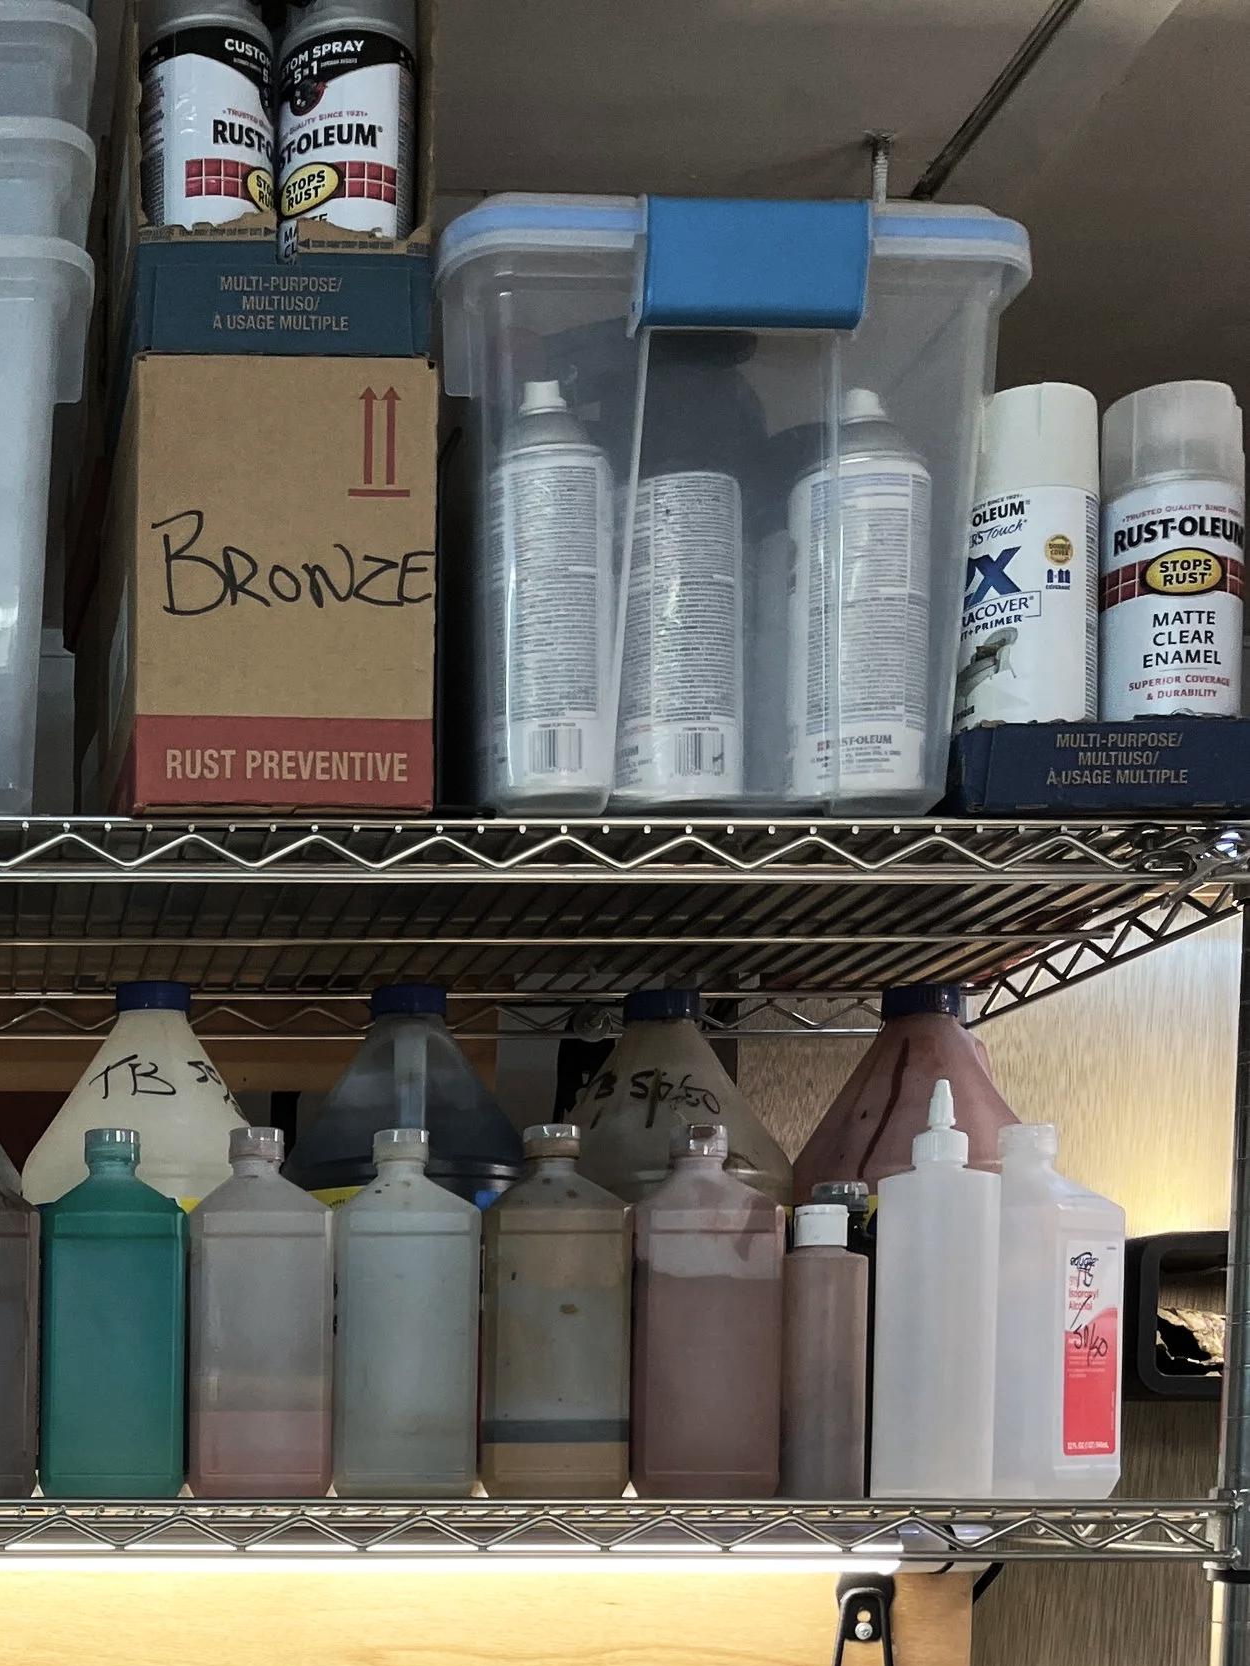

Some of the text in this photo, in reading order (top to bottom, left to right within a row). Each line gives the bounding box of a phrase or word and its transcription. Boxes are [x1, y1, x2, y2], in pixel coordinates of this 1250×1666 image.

[312, 40, 365, 59] SPRAY
[293, 68, 302, 84] 5
[311, 60, 318, 75] 1
[318, 111, 344, 121] SINCE
[285, 169, 326, 196] STOPS
[287, 186, 320, 211] RUST
[220, 276, 343, 292] MULTI-PURPOSE/
[242, 296, 319, 312] MULTIUSO/
[226, 315, 275, 330] USAGE
[279, 315, 349, 332] MULTIPLE
[1125, 507, 1162, 522] TRUSTED
[1165, 504, 1202, 513] QUALITY
[1205, 504, 1226, 514] SINCE
[151, 510, 435, 616] BRONZE
[1159, 558, 1212, 574] STOPS
[1163, 572, 1208, 587] RUST
[1152, 610, 1216, 628] MATTE
[1152, 630, 1214, 647] CLEAR
[1142, 649, 1222, 669] ENAMEL
[1128, 674, 1231, 691] SUPERIOR COVERAGE
[1157, 688, 1218, 699] DURABILITY
[1056, 732, 1183, 748] MULTI-PURPOSE/
[166, 748, 408, 783] RUST PREVENTIVE
[1078, 751, 1159, 766] MULTIUSO/
[1061, 770, 1111, 785] USAGE
[1116, 769, 1188, 784] MULTIPLE
[89, 1054, 176, 1099] TB
